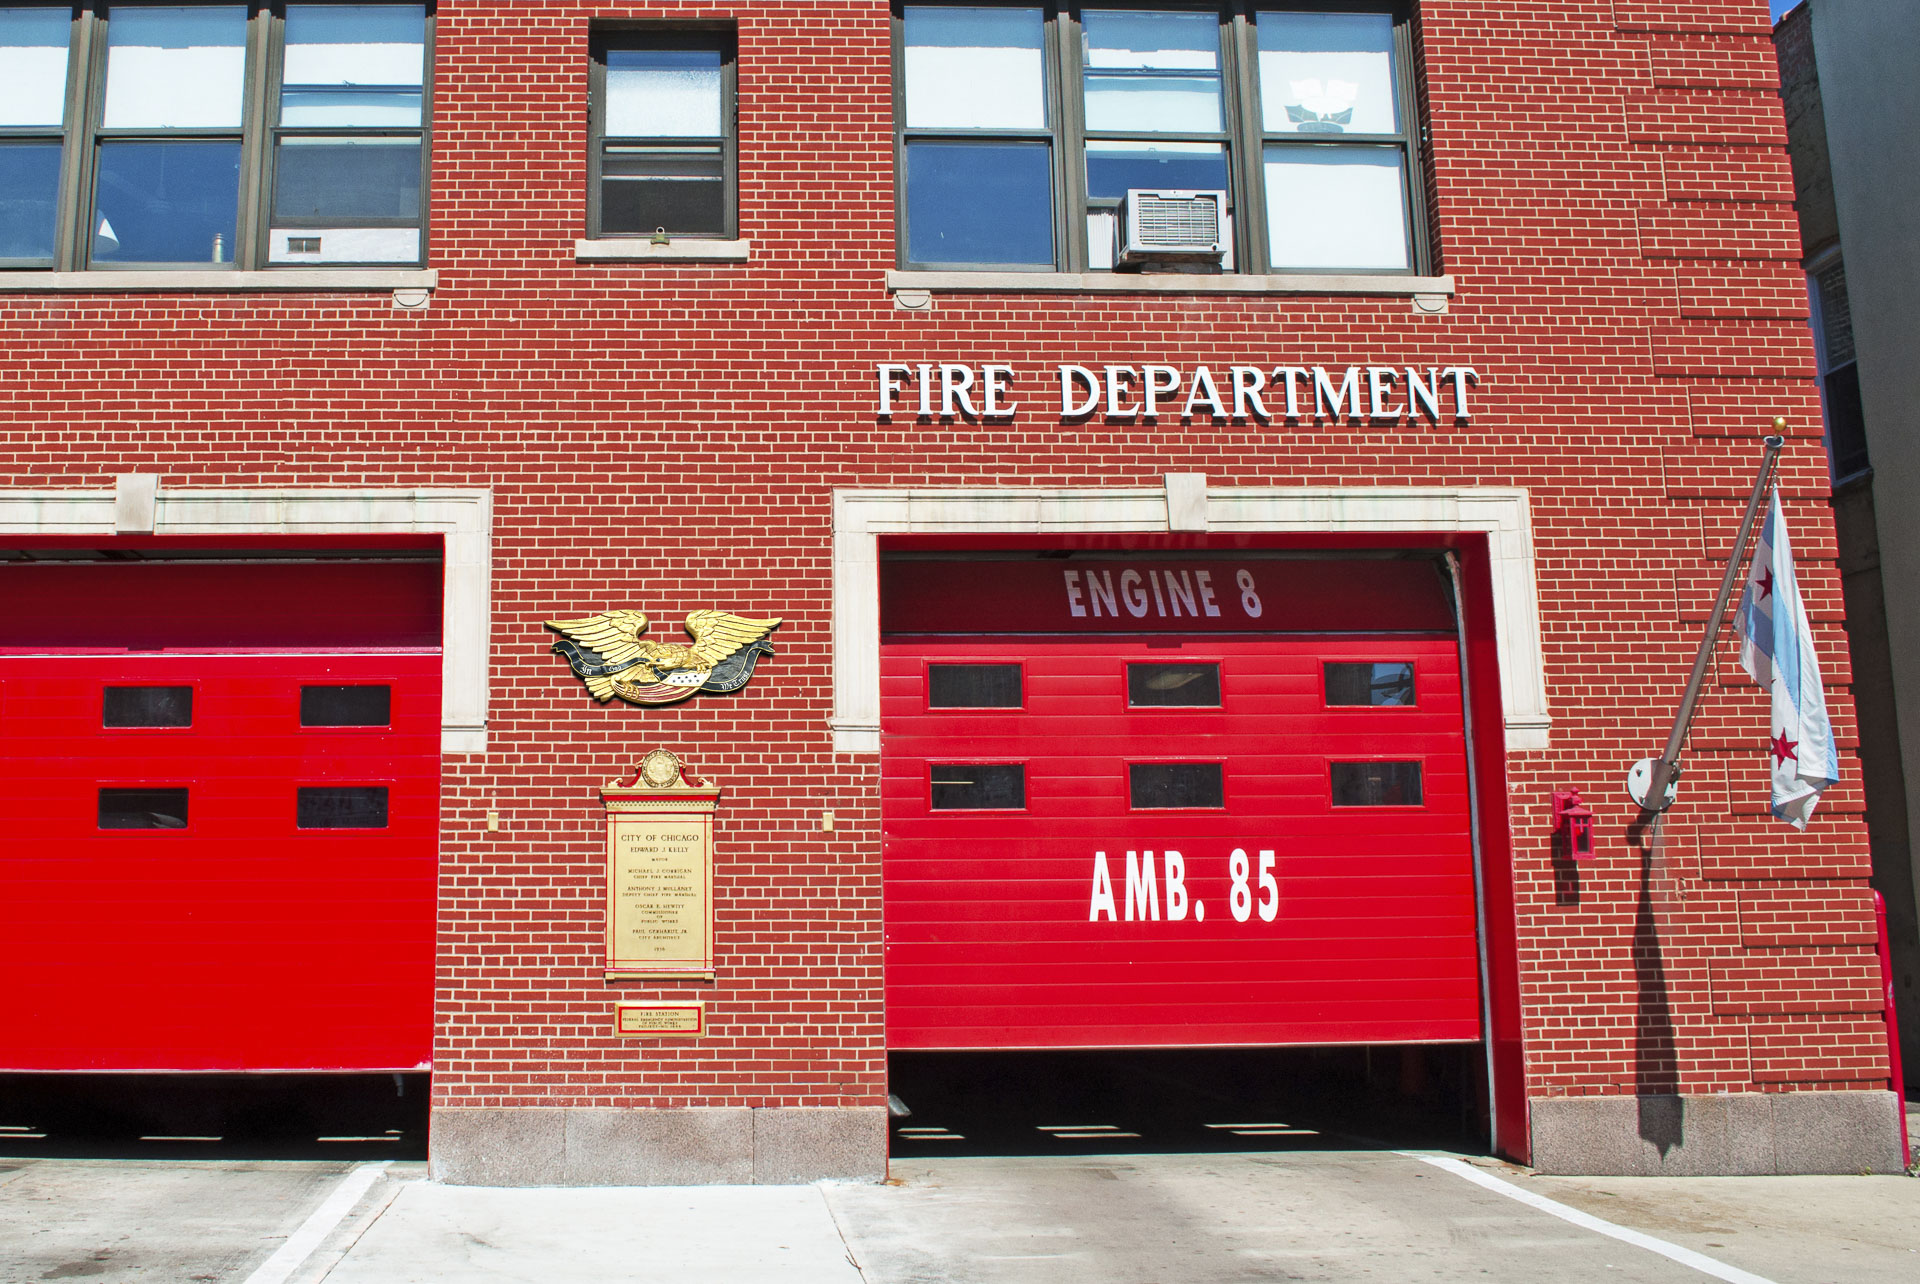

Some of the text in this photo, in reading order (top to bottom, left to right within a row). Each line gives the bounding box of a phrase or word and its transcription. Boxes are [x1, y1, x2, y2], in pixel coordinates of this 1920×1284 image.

[877, 363, 1479, 419] FIRE DEPARTMENT
[1064, 569, 1262, 618] ENGINE 8
[1089, 848, 1279, 922] AMB. 85
